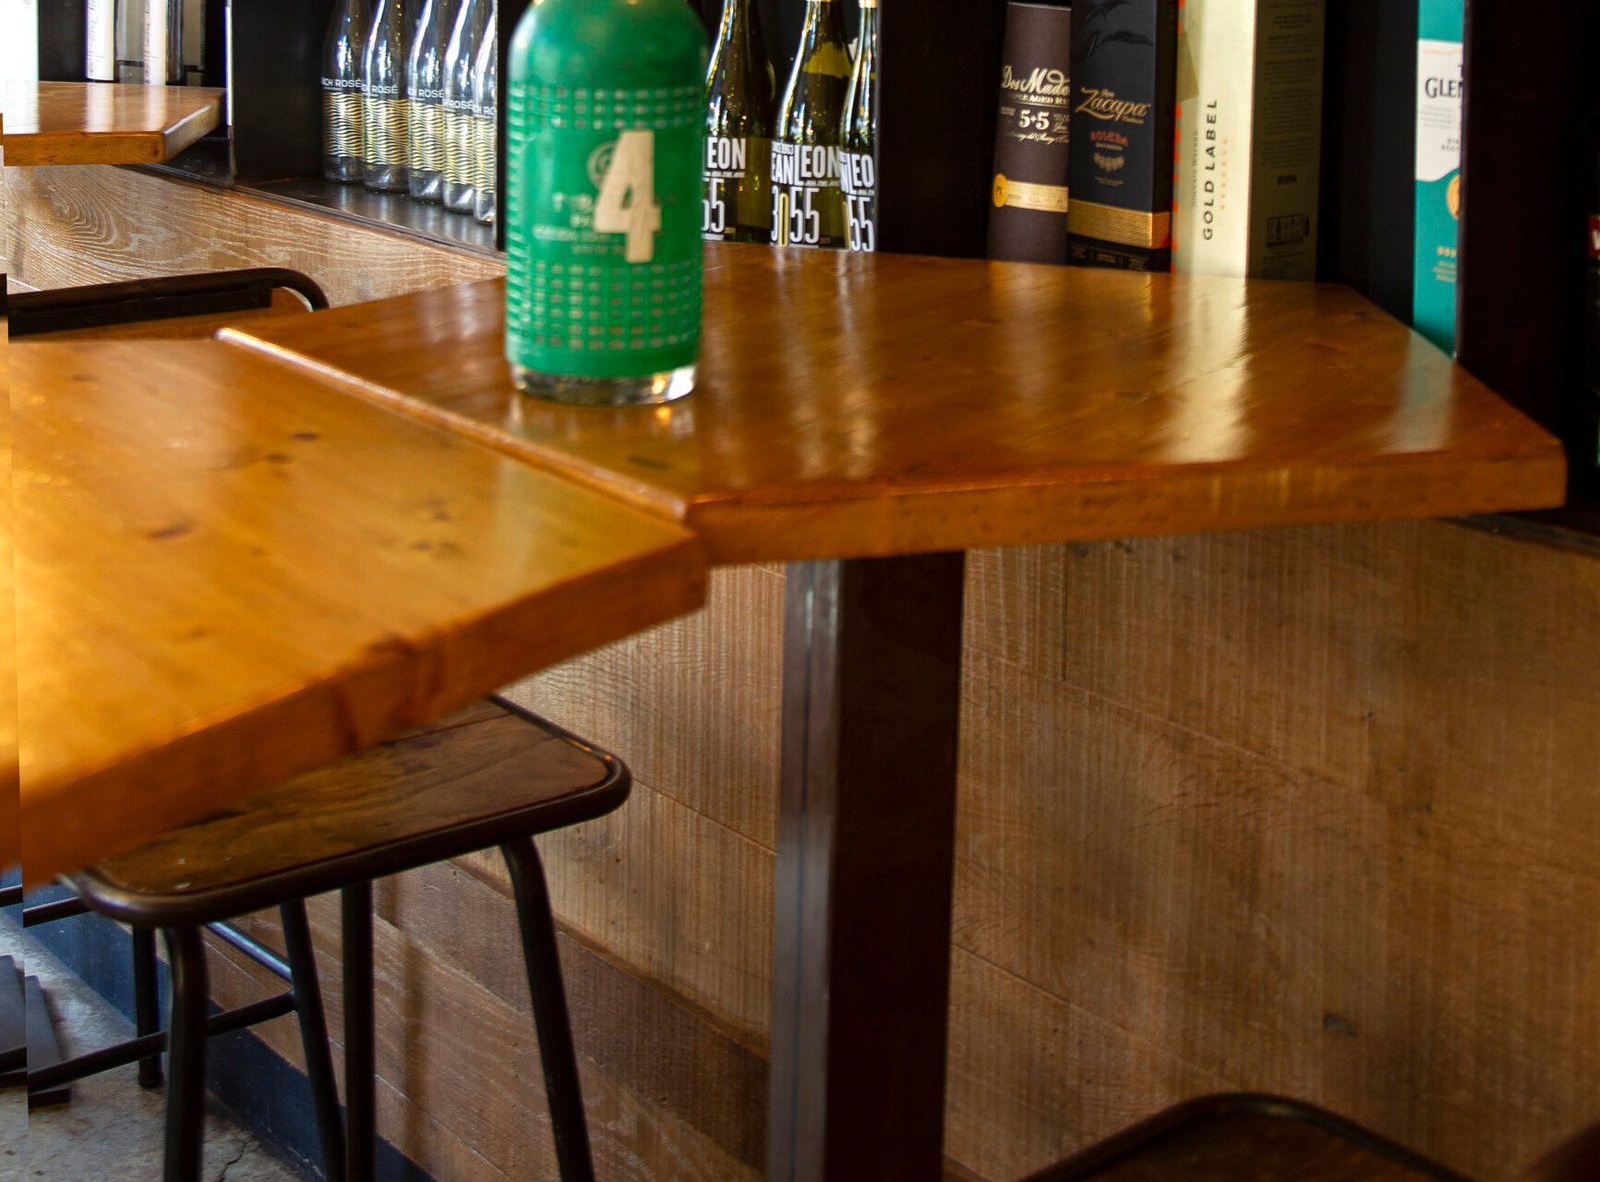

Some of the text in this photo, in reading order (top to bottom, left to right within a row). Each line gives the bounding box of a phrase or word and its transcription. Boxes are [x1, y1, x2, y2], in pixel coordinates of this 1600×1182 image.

[335, 77, 362, 88] ROSÉ
[372, 85, 398, 94] ROSÉ
[1019, 67, 1070, 96] Made
[1019, 109, 1050, 131] 5+5
[1075, 87, 1152, 122] Zacapa
[707, 137, 747, 171] EON
[1203, 100, 1217, 240] GOLD LABEL
[594, 129, 661, 263] 4
[702, 178, 726, 233] 55
